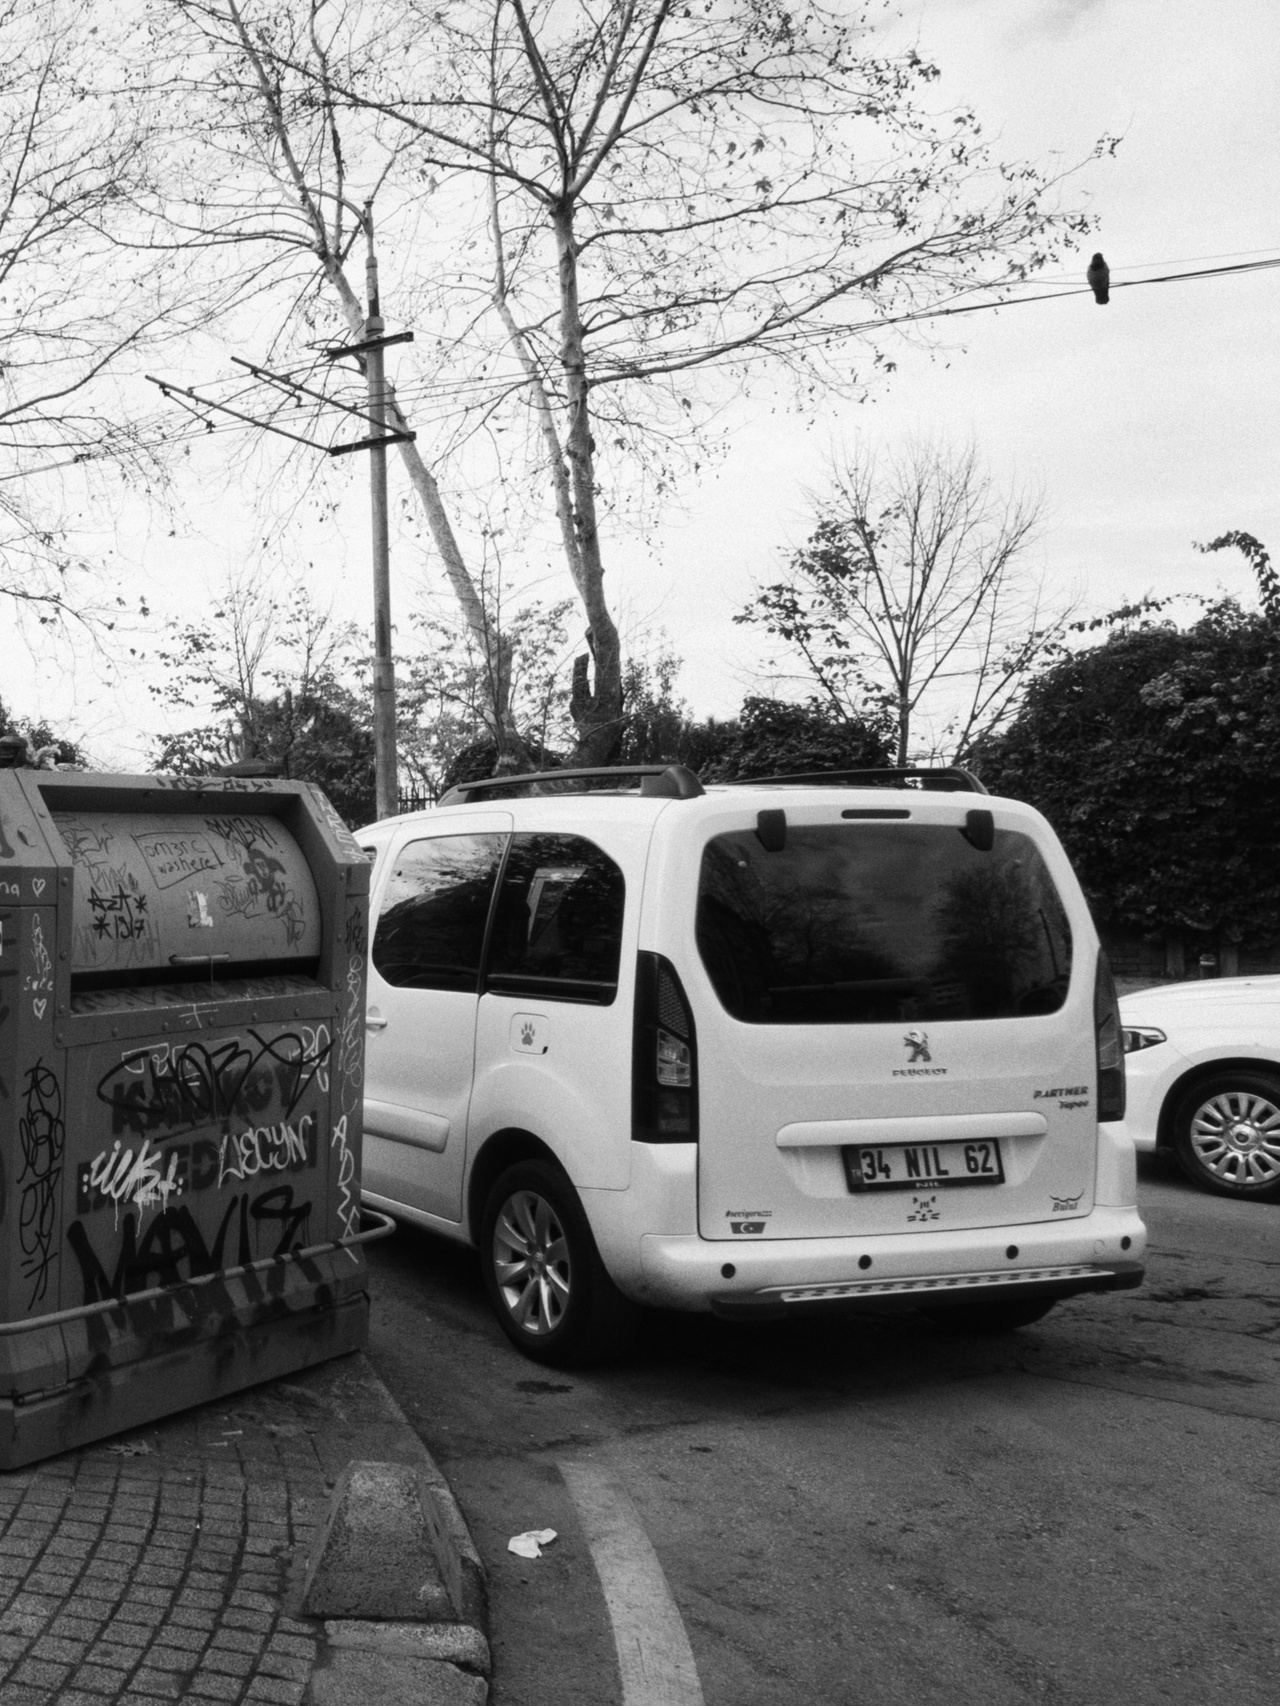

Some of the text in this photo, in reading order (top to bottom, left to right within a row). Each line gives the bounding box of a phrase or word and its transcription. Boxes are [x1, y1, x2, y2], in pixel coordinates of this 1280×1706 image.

[892, 1068, 948, 1077] PEUGEOT
[1033, 1086, 1089, 1099] PARTNER
[861, 1143, 995, 1181] 34 NIL 62
[851, 1168, 863, 1178] TR
